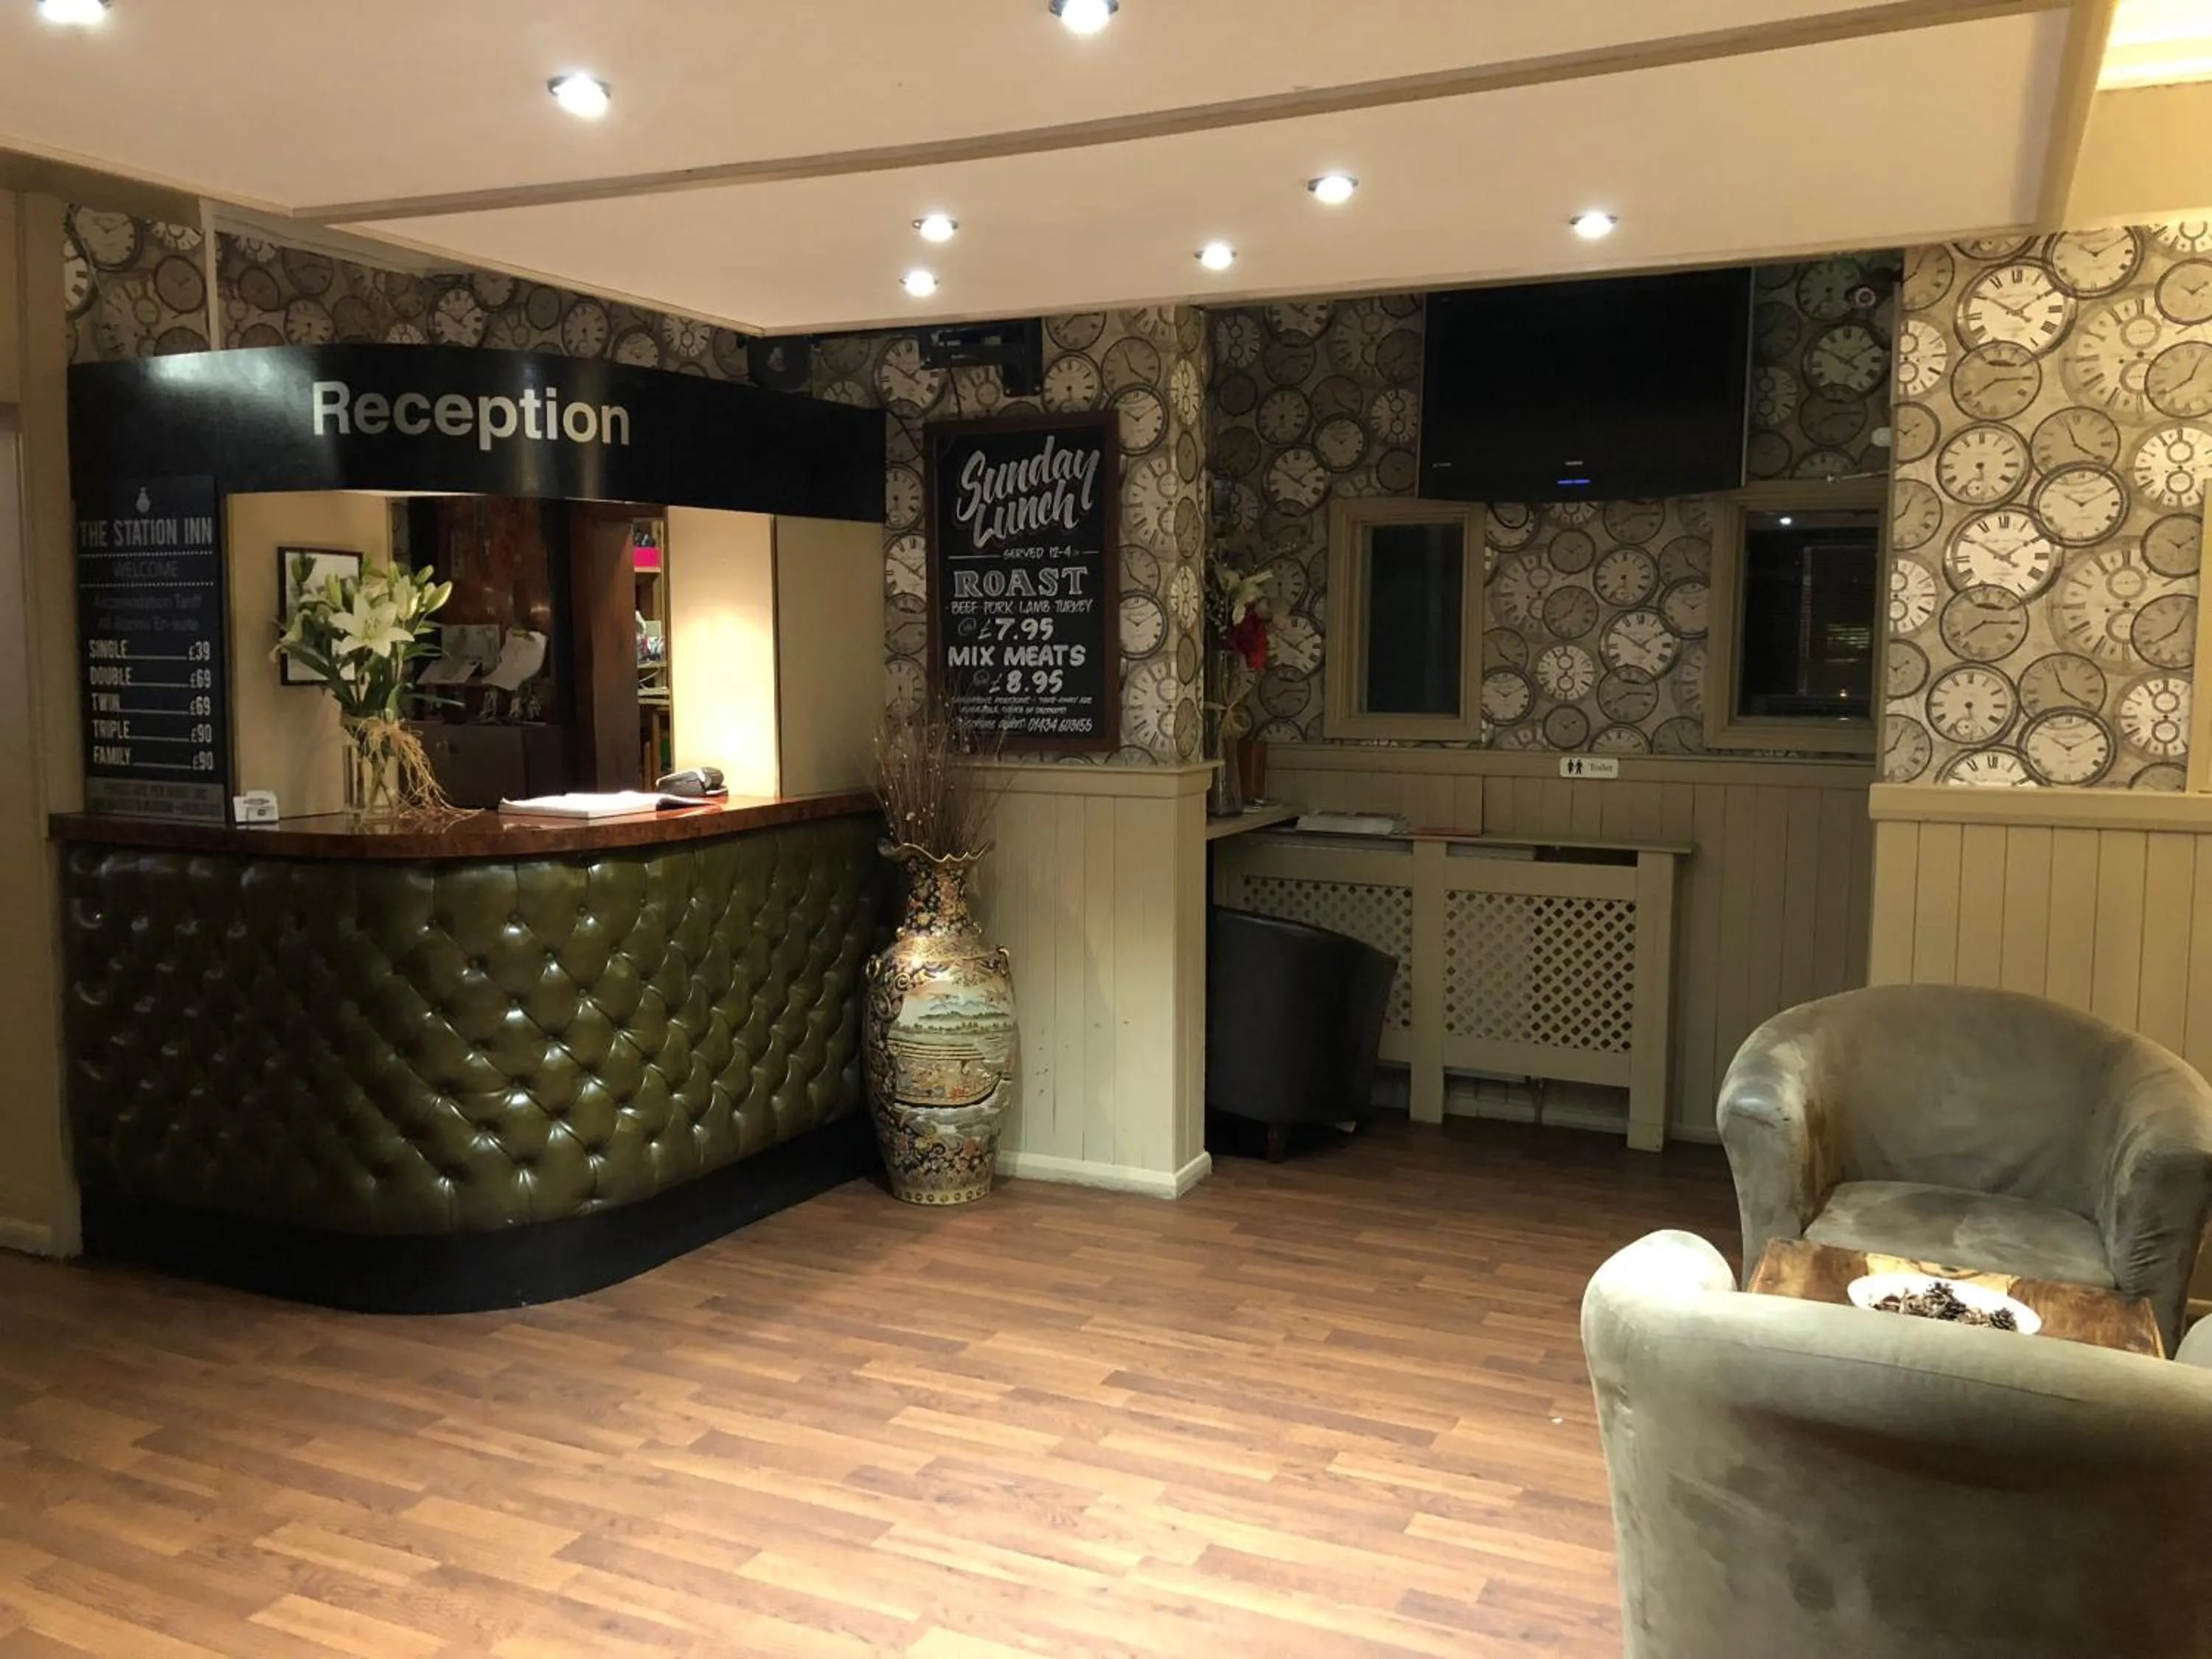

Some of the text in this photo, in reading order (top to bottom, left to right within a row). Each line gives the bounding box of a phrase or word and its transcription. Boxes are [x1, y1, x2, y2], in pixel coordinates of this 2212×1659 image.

[313, 381, 630, 451] Reception
[956, 435, 1100, 521] Sunday
[973, 479, 1079, 548] Lunch
[80, 517, 213, 546] THE STATION INN
[1003, 546, 1045, 559] SERVED
[953, 566, 1088, 598] ROAST
[950, 598, 1093, 615] BEEF PORK LAMB TURKEY
[89, 639, 211, 661] SINGLE £39
[947, 644, 1087, 667] MIX MEATS
[89, 667, 212, 689] DOUBLE £69
[91, 692, 121, 712] TWIN
[92, 719, 212, 743] TRIPLE £90
[94, 745, 213, 771] FAMILY £90
